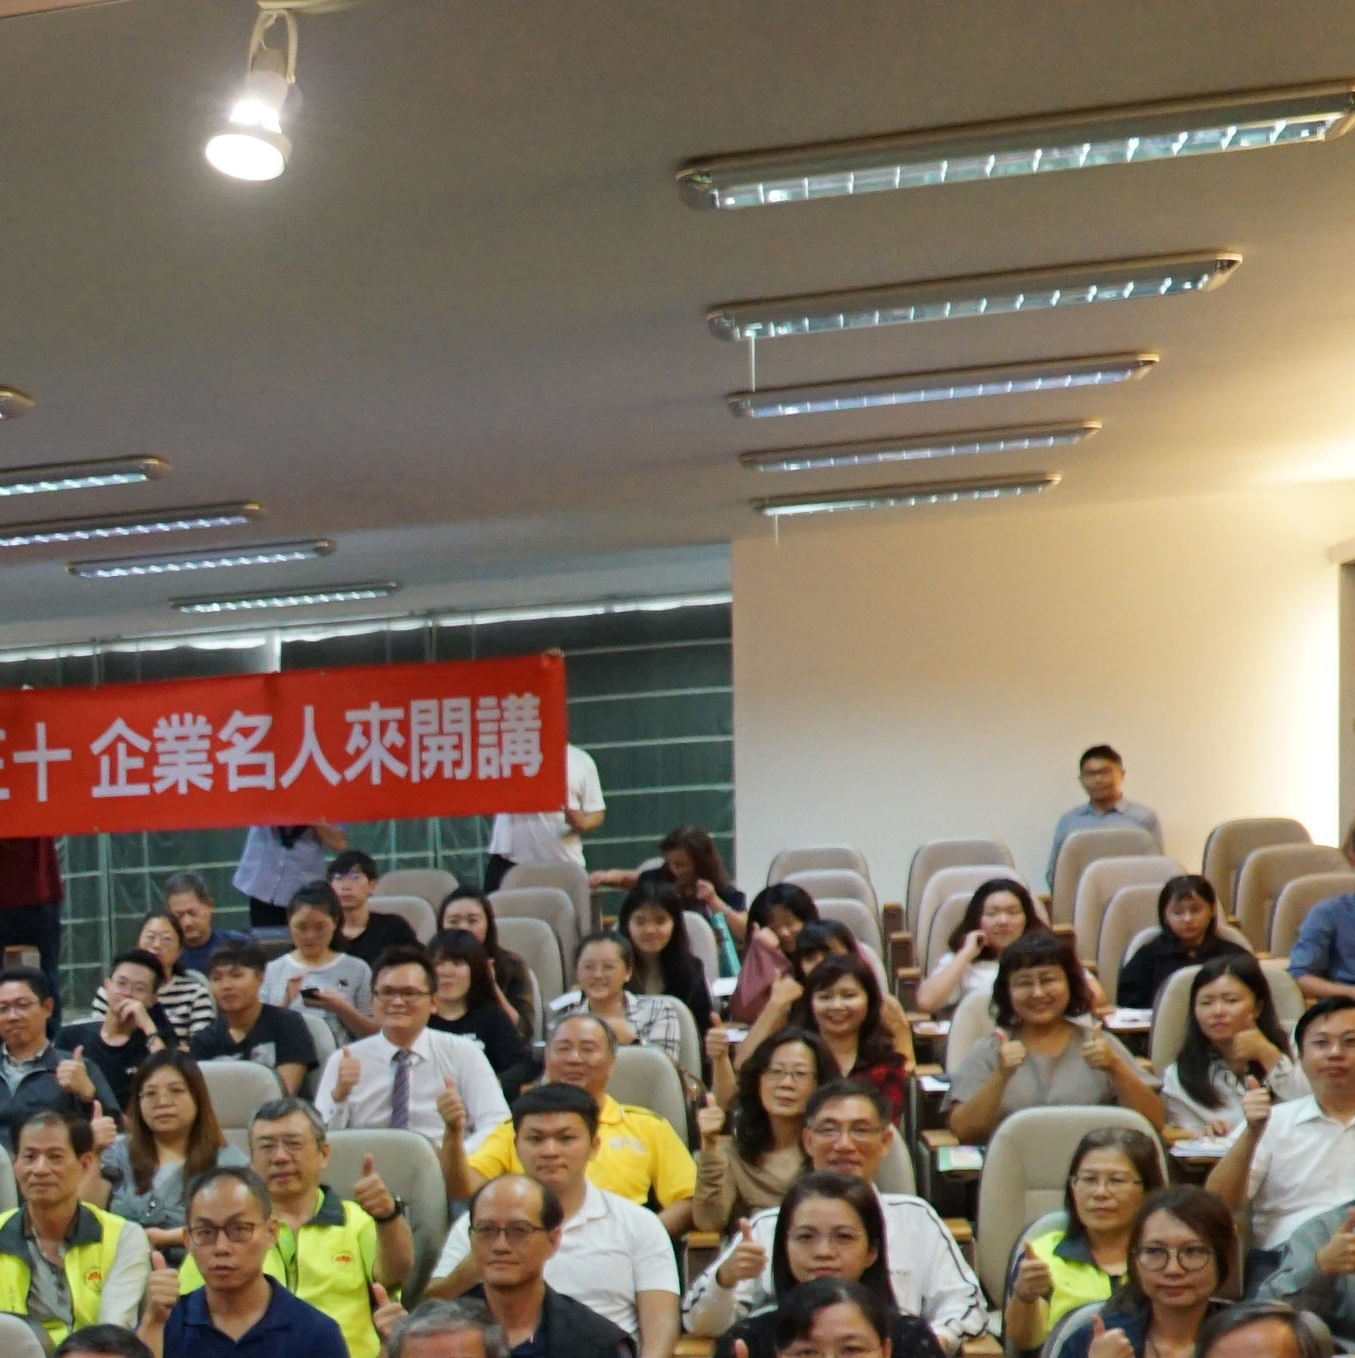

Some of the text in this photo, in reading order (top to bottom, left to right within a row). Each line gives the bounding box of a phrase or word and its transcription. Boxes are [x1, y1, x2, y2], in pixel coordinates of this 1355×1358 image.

[90, 692, 543, 798] 企業名人來開講
